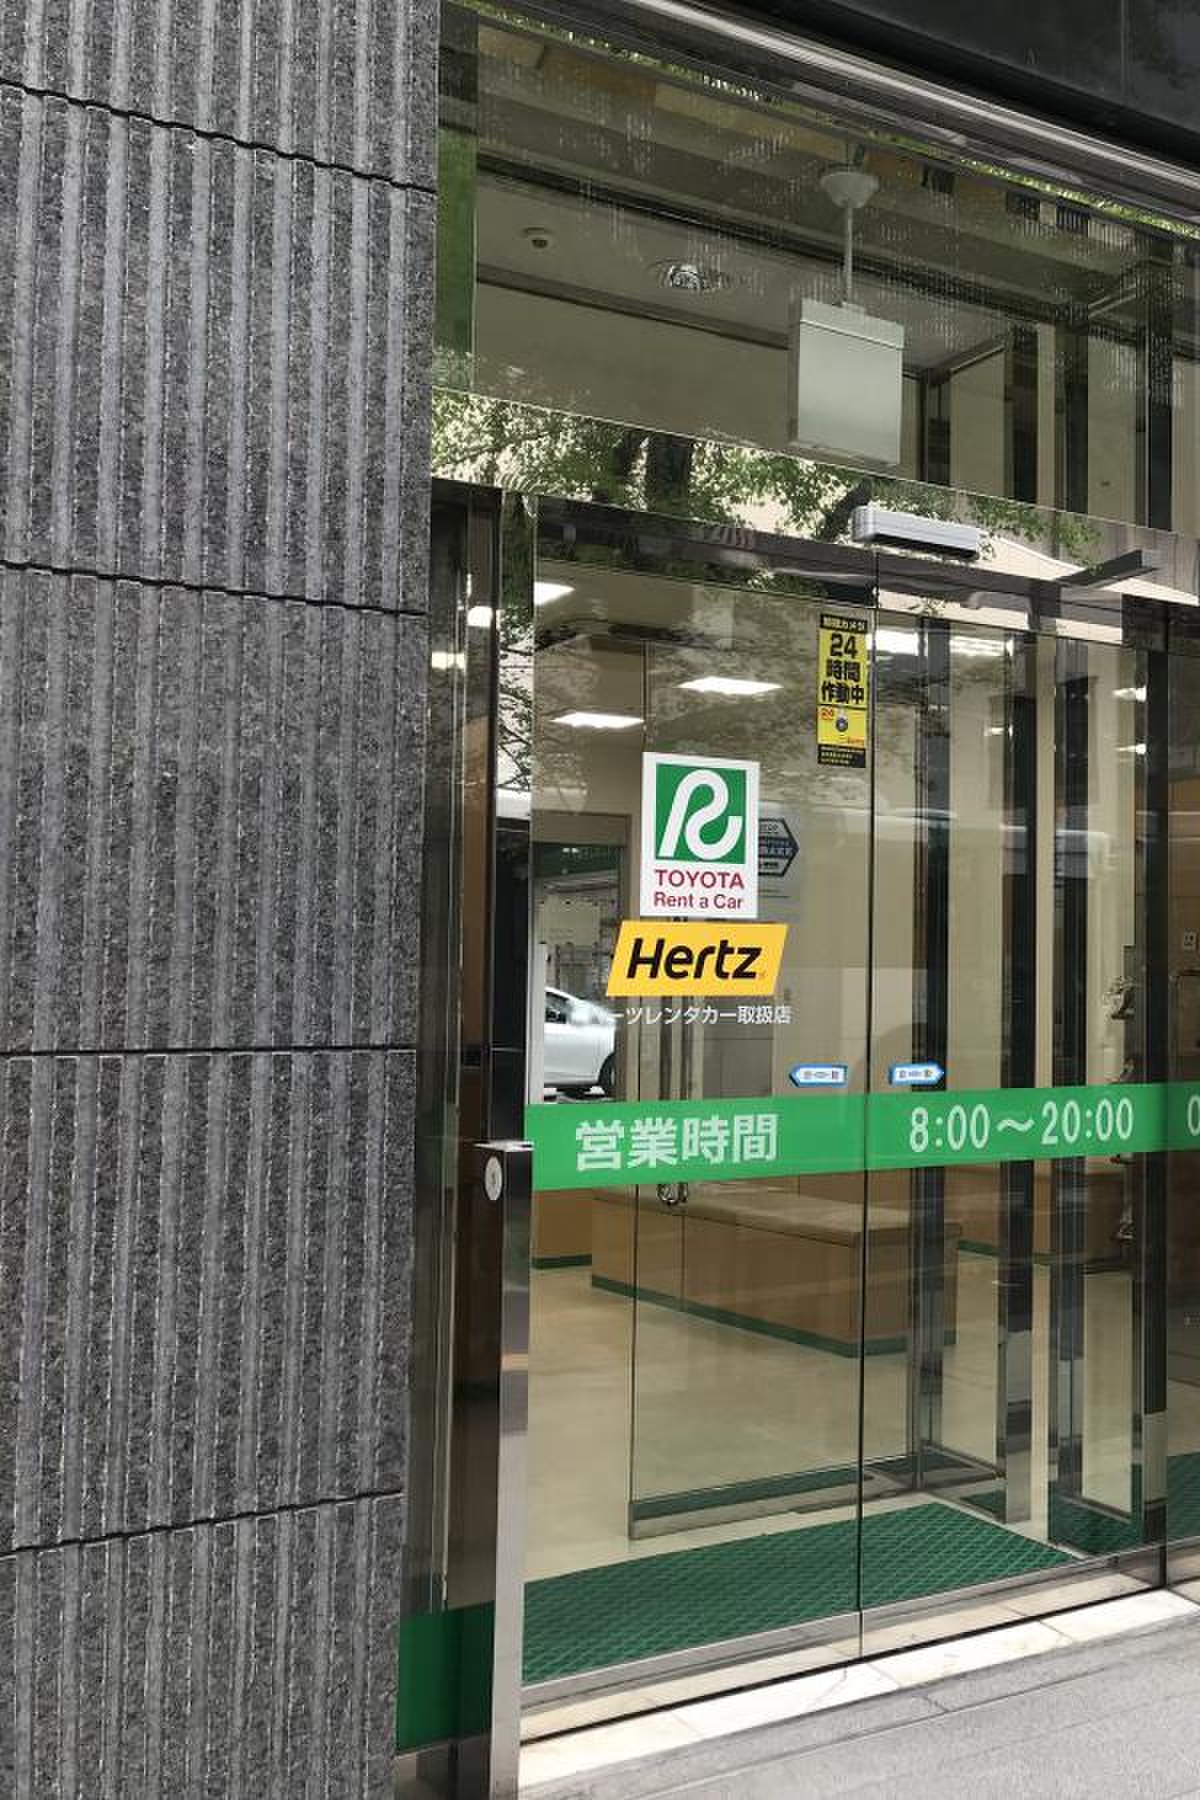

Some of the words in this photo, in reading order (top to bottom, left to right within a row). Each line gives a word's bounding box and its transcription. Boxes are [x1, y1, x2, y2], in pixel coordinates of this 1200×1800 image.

[830, 632, 859, 660] 24
[826, 659, 861, 683] 時間
[820, 680, 865, 705] 作動中
[654, 868, 745, 890] TOYOTA
[653, 890, 694, 908] Rent
[699, 895, 709, 909] a
[713, 893, 744, 910] Car
[626, 937, 763, 980] Hertz
[574, 1113, 779, 1172] 営業時間
